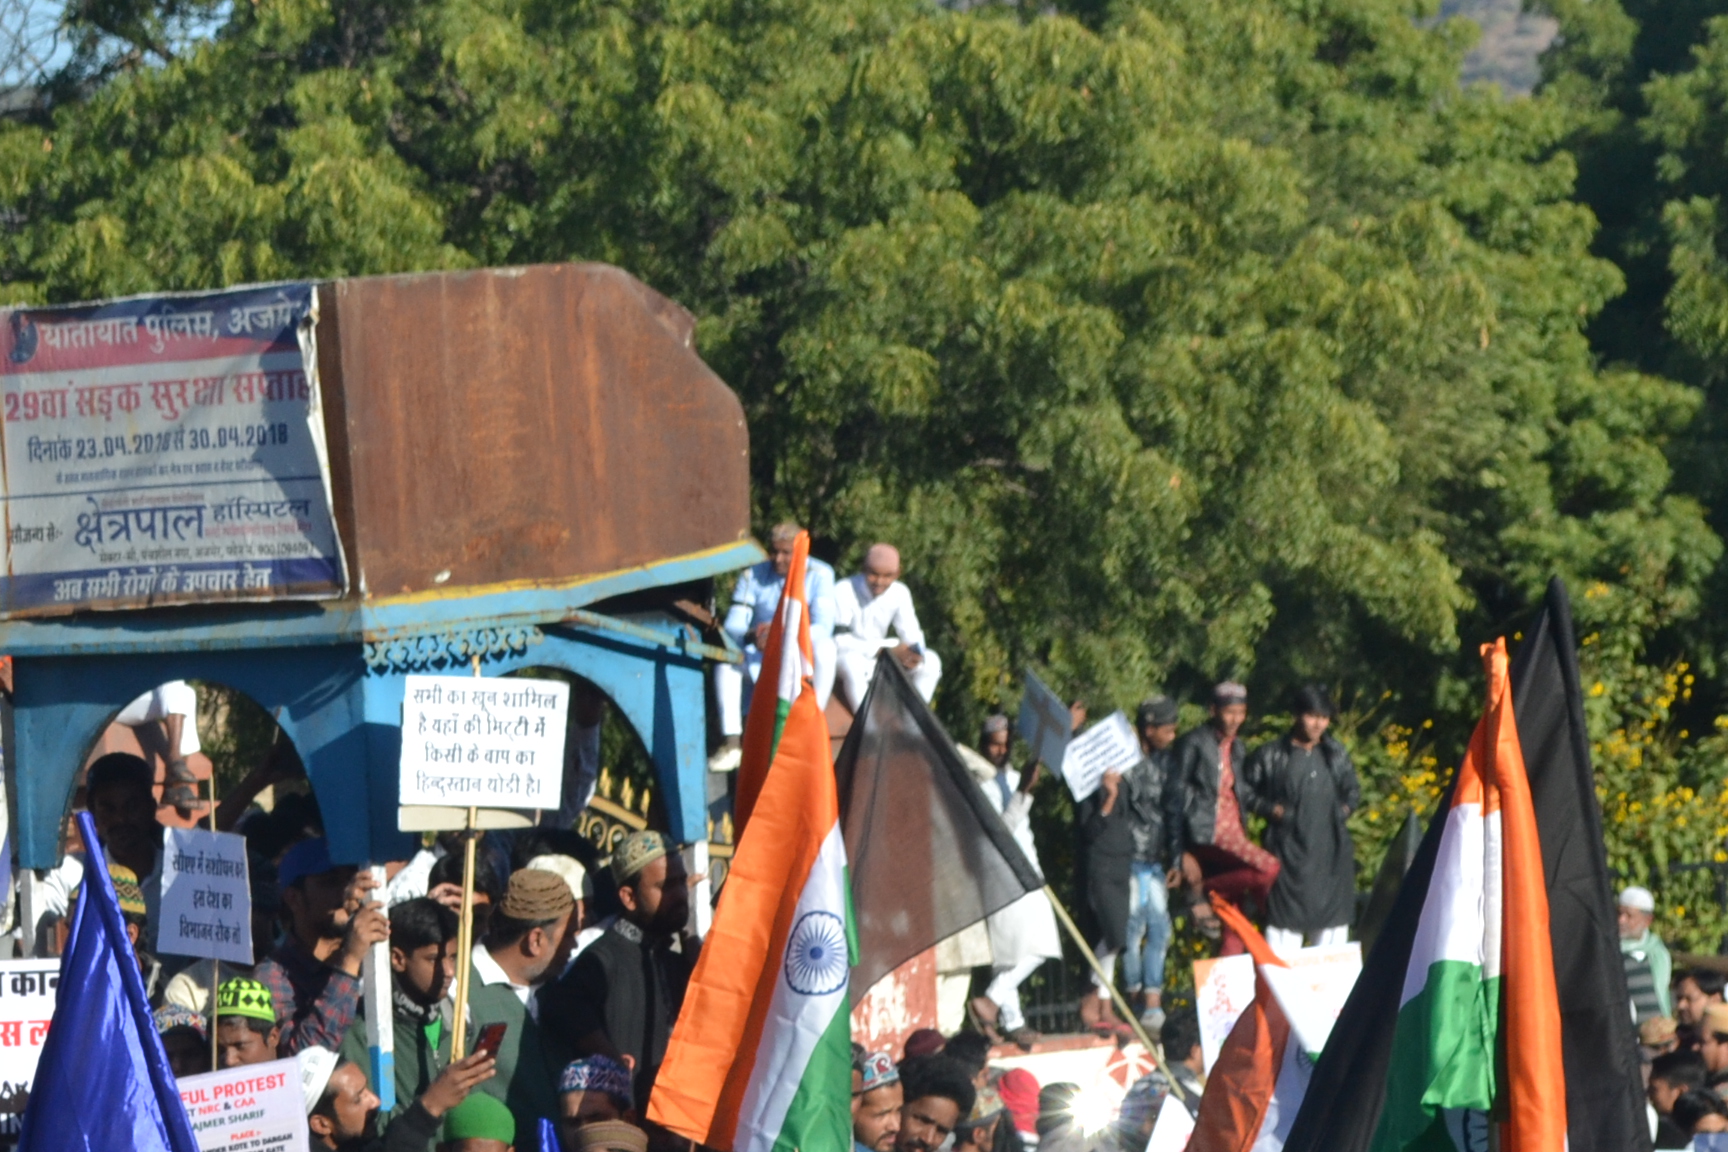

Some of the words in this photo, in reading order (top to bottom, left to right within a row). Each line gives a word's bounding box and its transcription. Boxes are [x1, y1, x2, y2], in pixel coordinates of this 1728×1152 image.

[39, 316, 139, 350] यातायात
[75, 380, 143, 424] सड़क
[149, 374, 226, 421] सुरक्षा
[189, 421, 289, 454] 30.04.2018
[74, 495, 207, 552] क्षेत्रपाल
[413, 683, 442, 705] सभी
[447, 688, 466, 705] का
[503, 686, 559, 709] शामिल
[463, 713, 482, 735] की
[425, 740, 463, 764] किसी
[467, 742, 480, 764] के
[516, 750, 536, 766] का
[213, 1072, 286, 1101] PROTEST
[198, 1102, 222, 1117] NRC
[223, 1101, 232, 1112] &
[234, 1096, 257, 1110] CAA
[228, 1108, 266, 1125] SHARIF
[250, 1139, 261, 1148] TO
